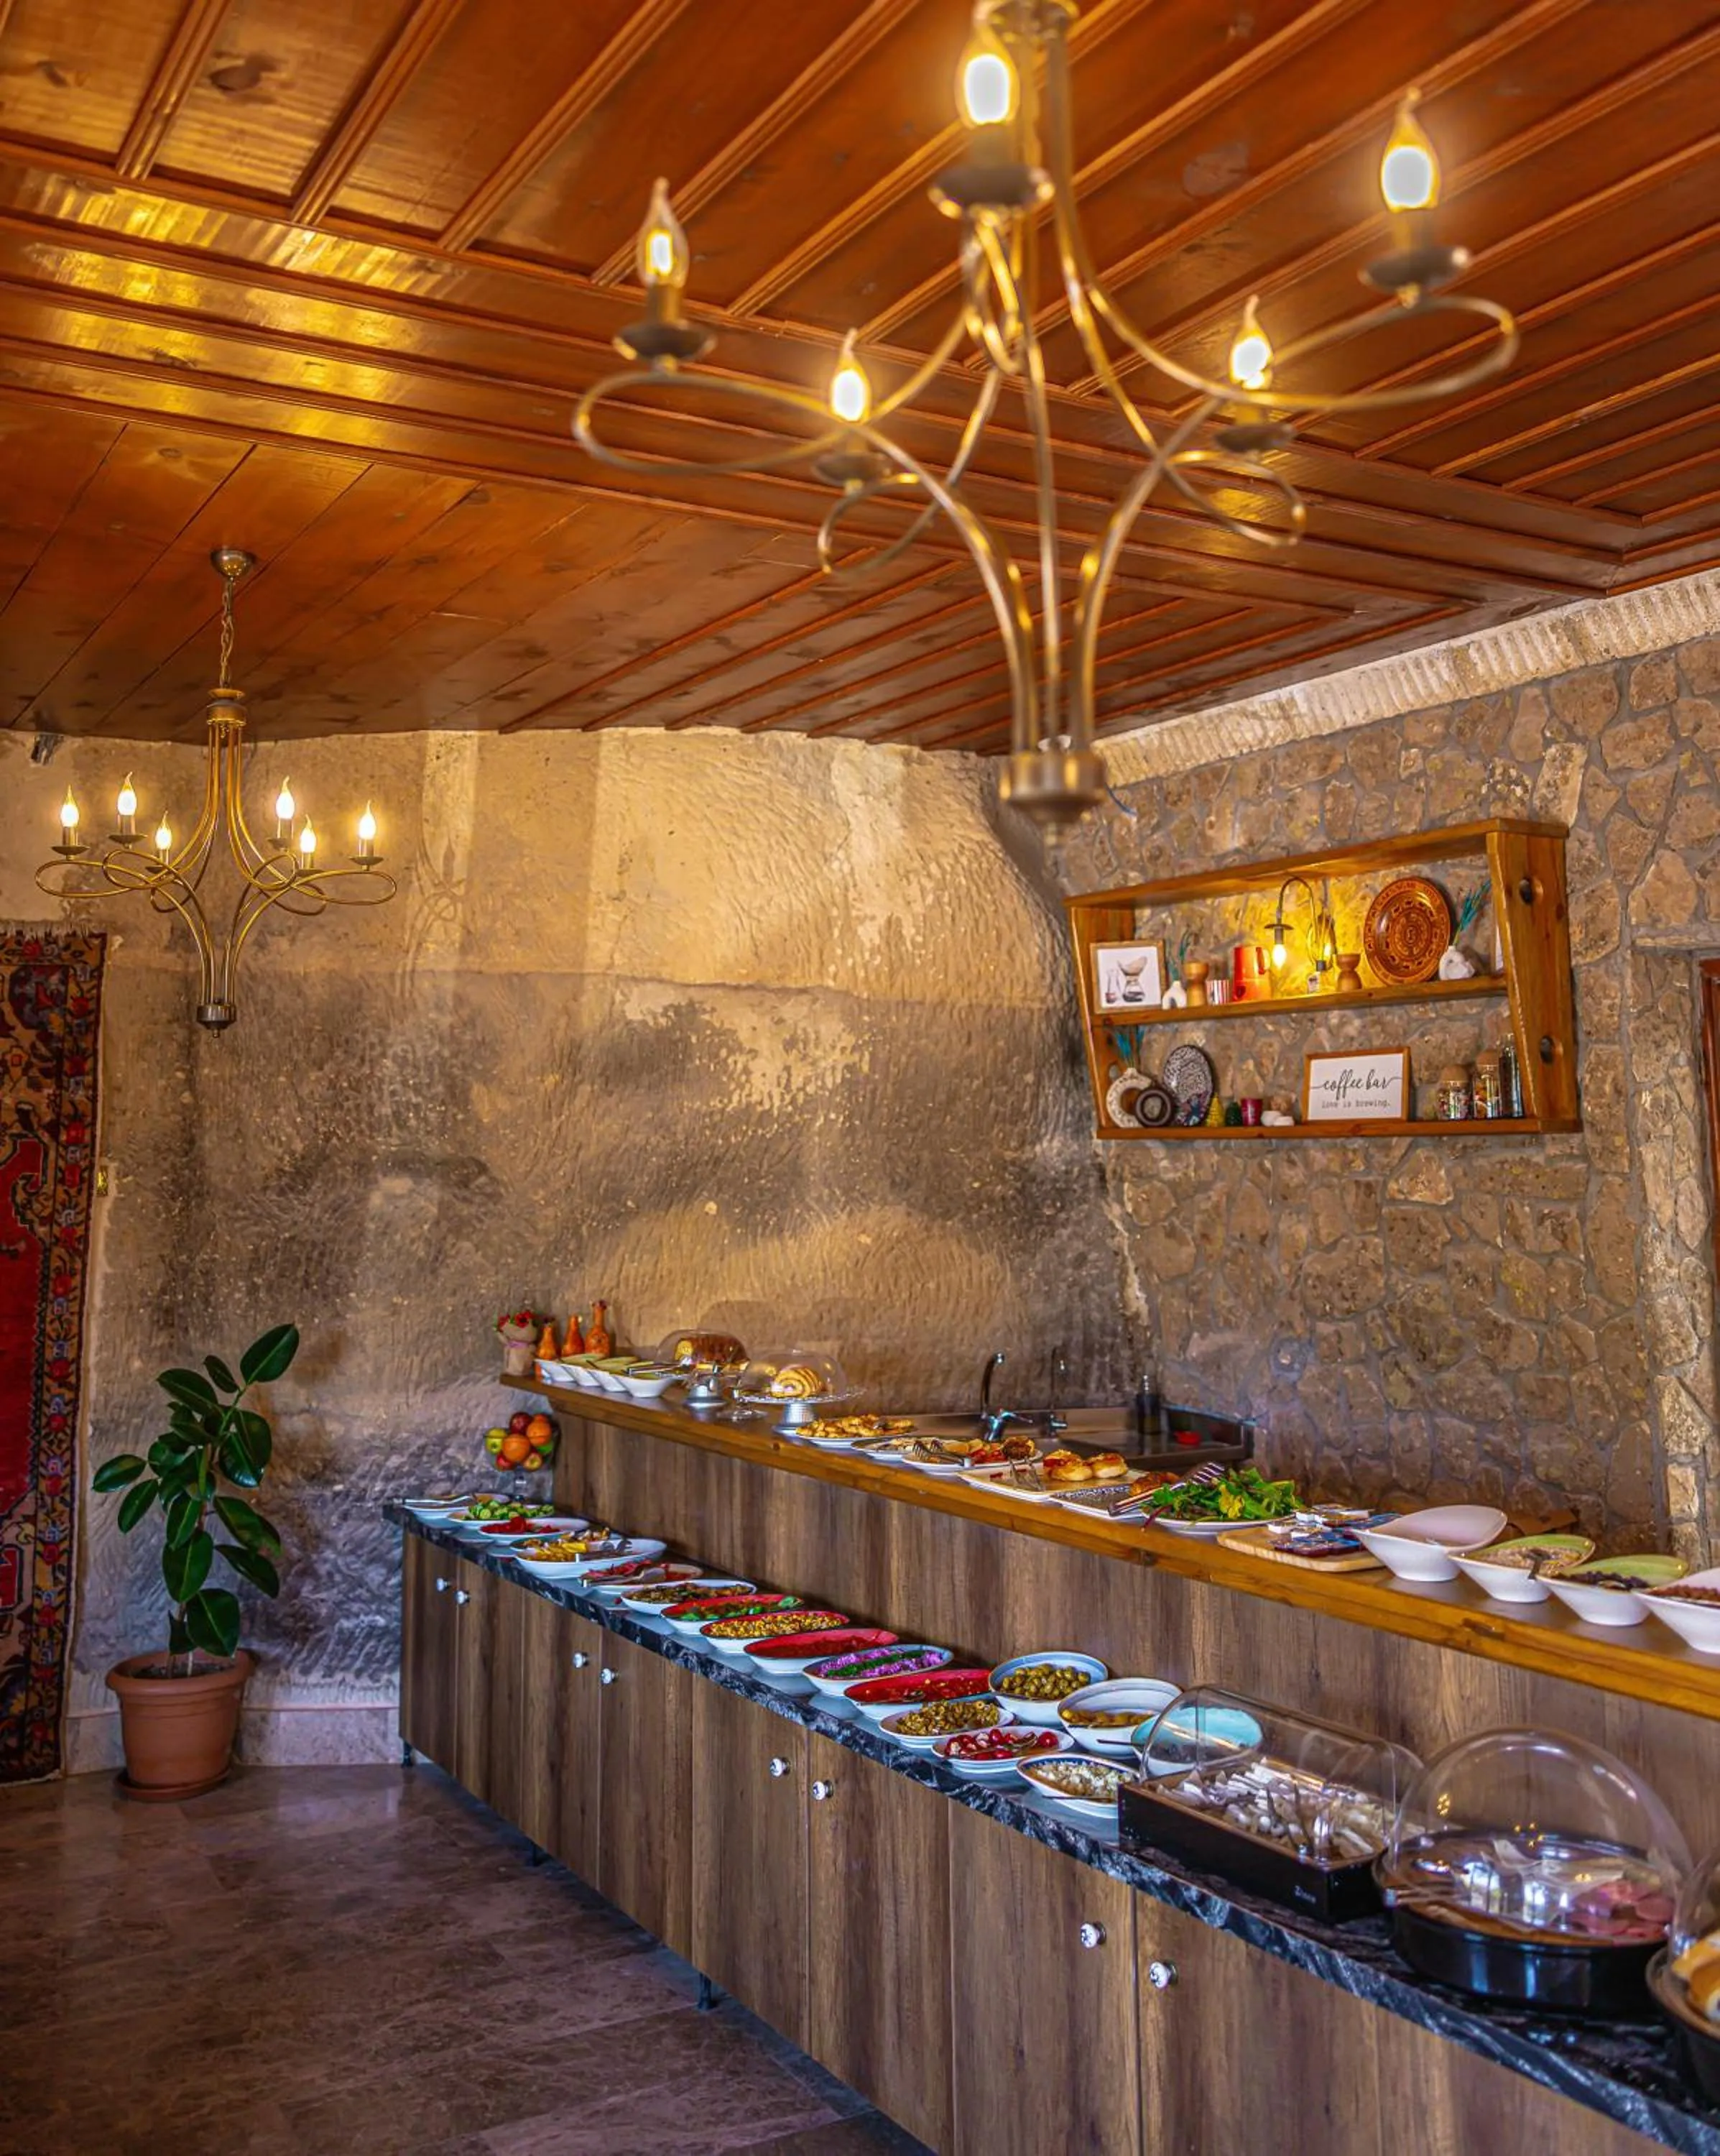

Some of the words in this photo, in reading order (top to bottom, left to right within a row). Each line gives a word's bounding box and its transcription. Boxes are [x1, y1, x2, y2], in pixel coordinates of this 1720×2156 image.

[1316, 1069, 1364, 1100] coffee
[1366, 1069, 1397, 1090] bar
[1342, 1100, 1351, 1108] is
